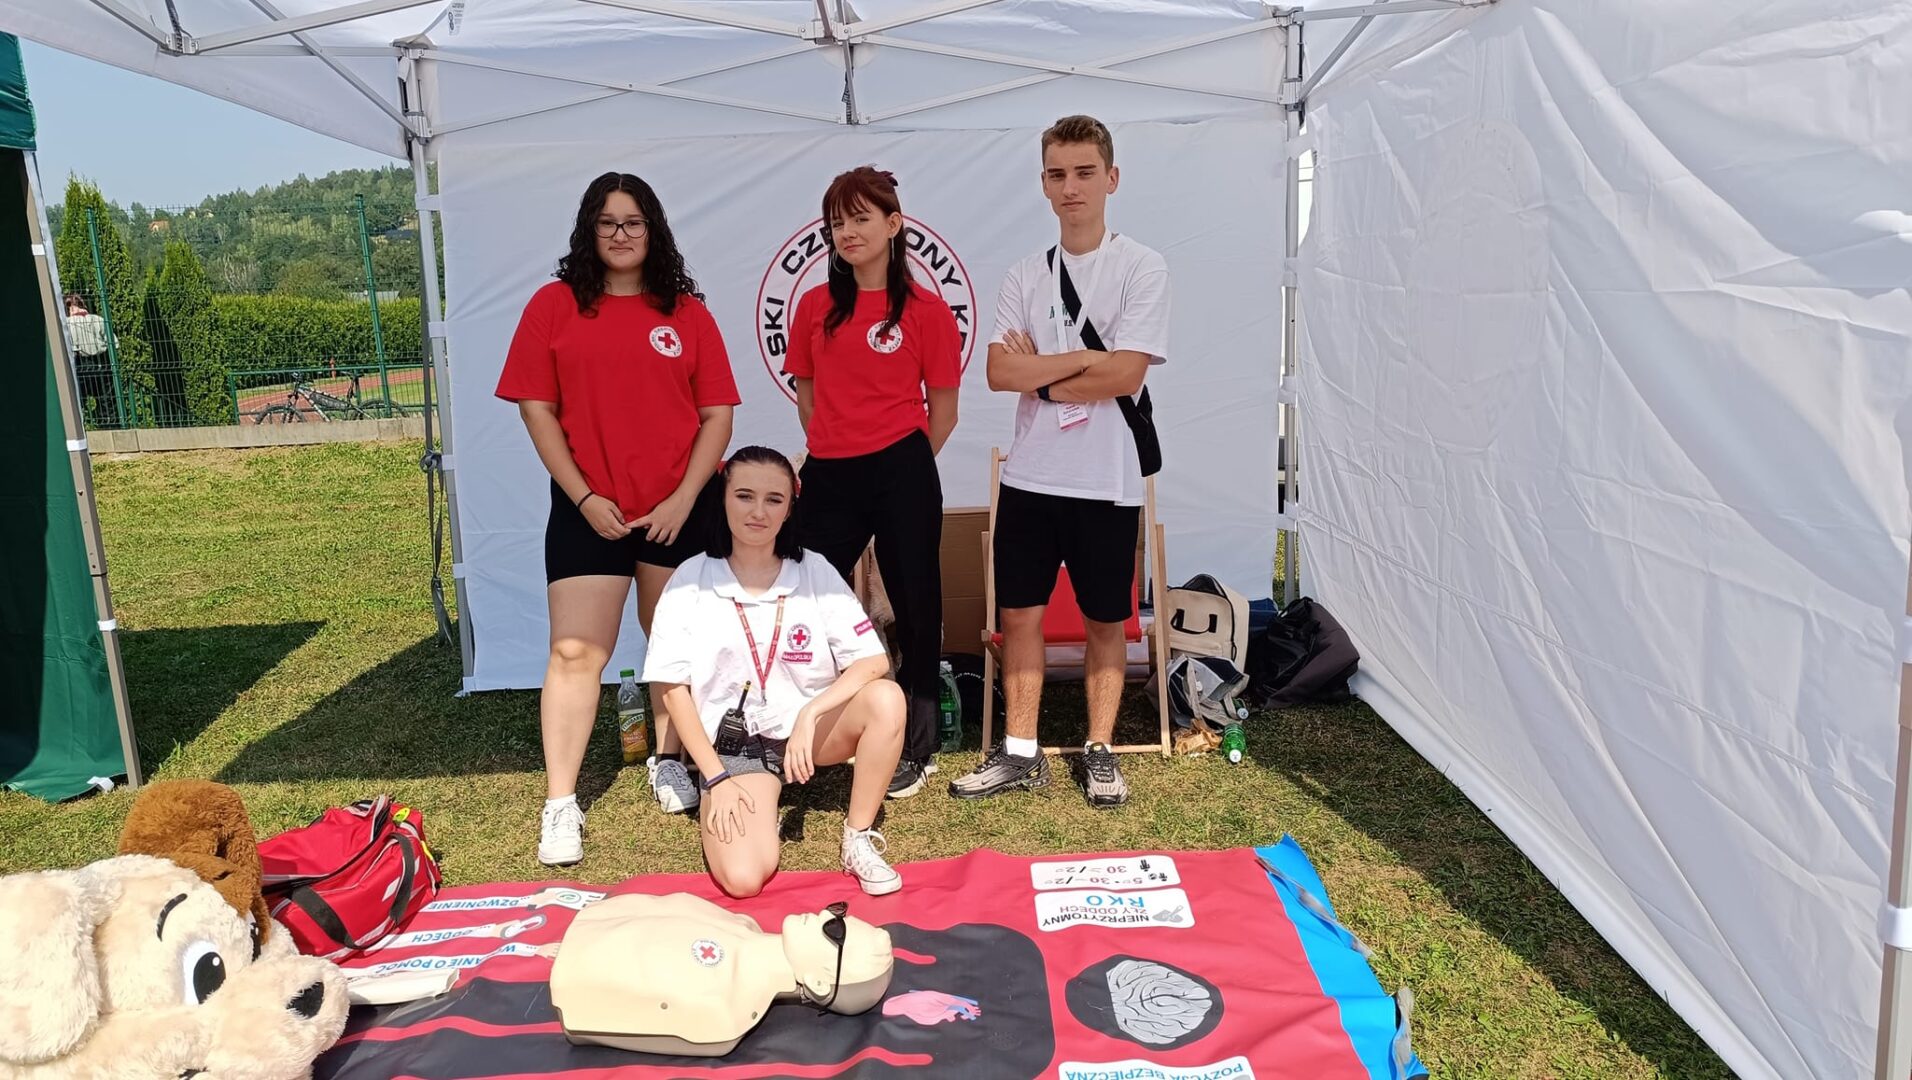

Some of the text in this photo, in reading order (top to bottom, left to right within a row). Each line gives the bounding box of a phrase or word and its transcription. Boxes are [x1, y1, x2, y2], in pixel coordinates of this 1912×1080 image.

[1106, 865, 1127, 874] 30
[1089, 877, 1109, 885] 30
[428, 898, 520, 911] DZWONIENIE
[1086, 895, 1144, 908] RKO
[1060, 905, 1118, 915] ODDECH
[1042, 913, 1149, 927] NIEPRZYTOMNY
[375, 958, 433, 974] POMOC
